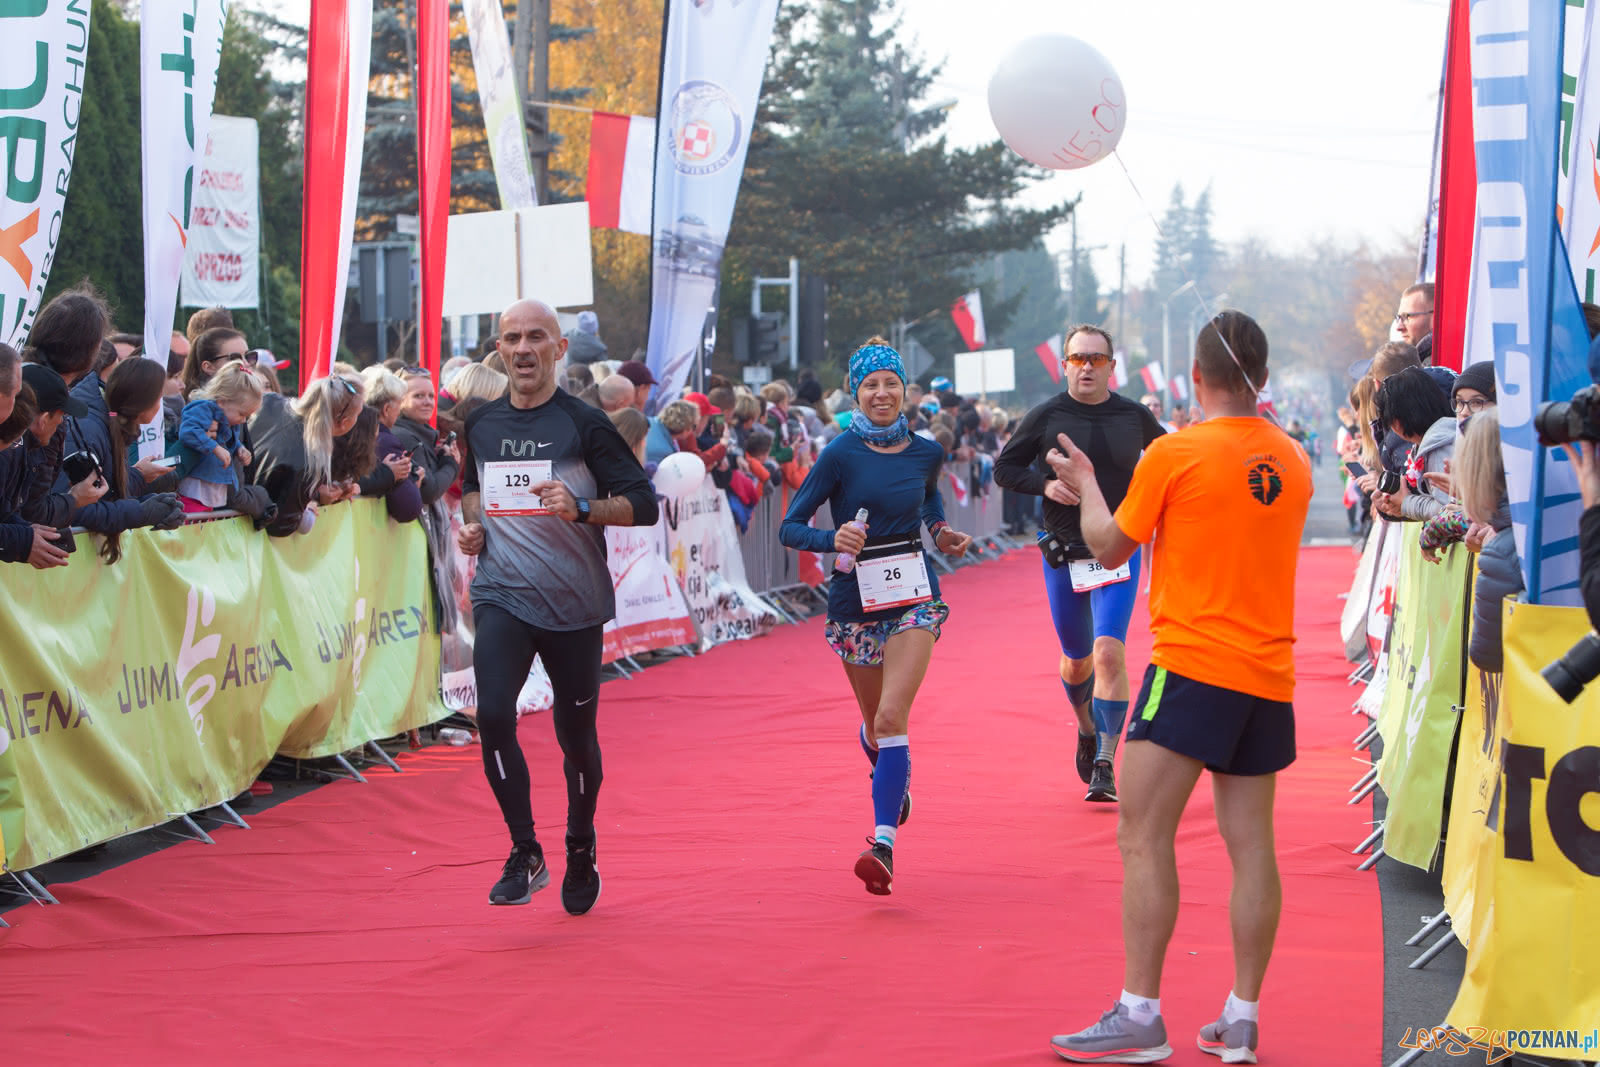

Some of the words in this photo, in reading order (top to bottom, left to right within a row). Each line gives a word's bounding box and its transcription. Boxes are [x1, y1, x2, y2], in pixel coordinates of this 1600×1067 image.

[500, 439, 536, 457] run
[505, 474, 530, 487] 129
[883, 567, 901, 581] 26
[117, 661, 180, 714] JUMI
[220, 638, 293, 691] ARENA
